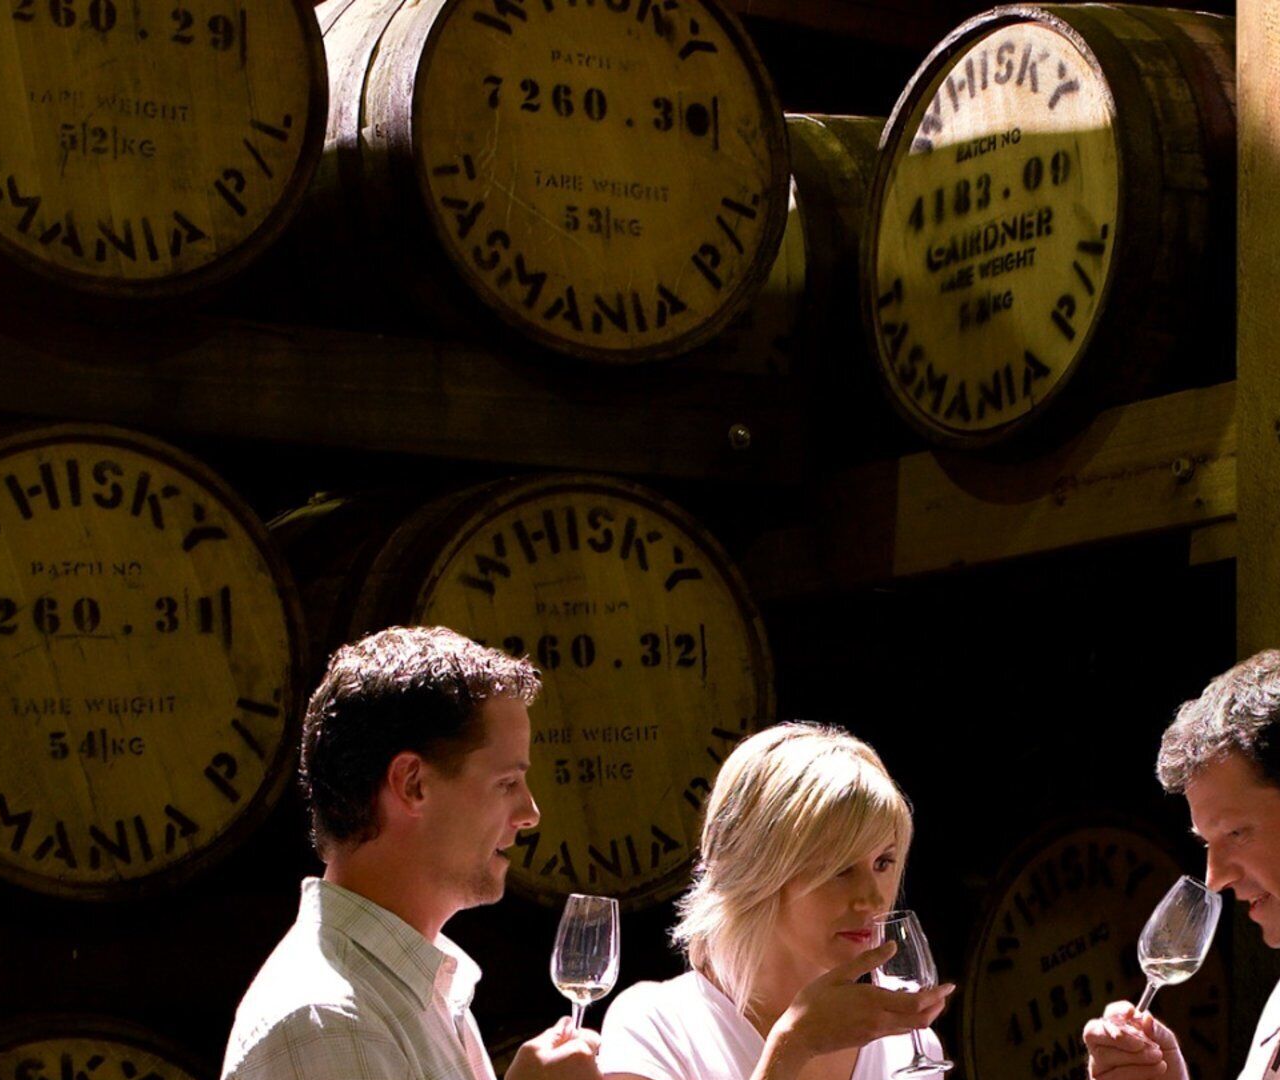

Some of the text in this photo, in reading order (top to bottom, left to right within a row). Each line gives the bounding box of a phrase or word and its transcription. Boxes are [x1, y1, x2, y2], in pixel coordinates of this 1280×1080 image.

[914, 40, 1080, 154] WHISKY
[956, 128, 1021, 163] BATCH NO
[534, 169, 671, 203] TARE WEIGHT
[565, 205, 643, 237] 53 KG
[433, 154, 687, 334] TASMANIA
[979, 247, 1037, 281] WEIGHT
[877, 279, 1050, 422] TASMANIA
[461, 506, 703, 598] WHISKY
[480, 633, 698, 669] 260.32
[533, 725, 660, 745] ARE WEIGHT
[554, 757, 634, 785] 53 KG
[989, 843, 1154, 972] WHISKY
[1040, 935, 1086, 973] BATCH
